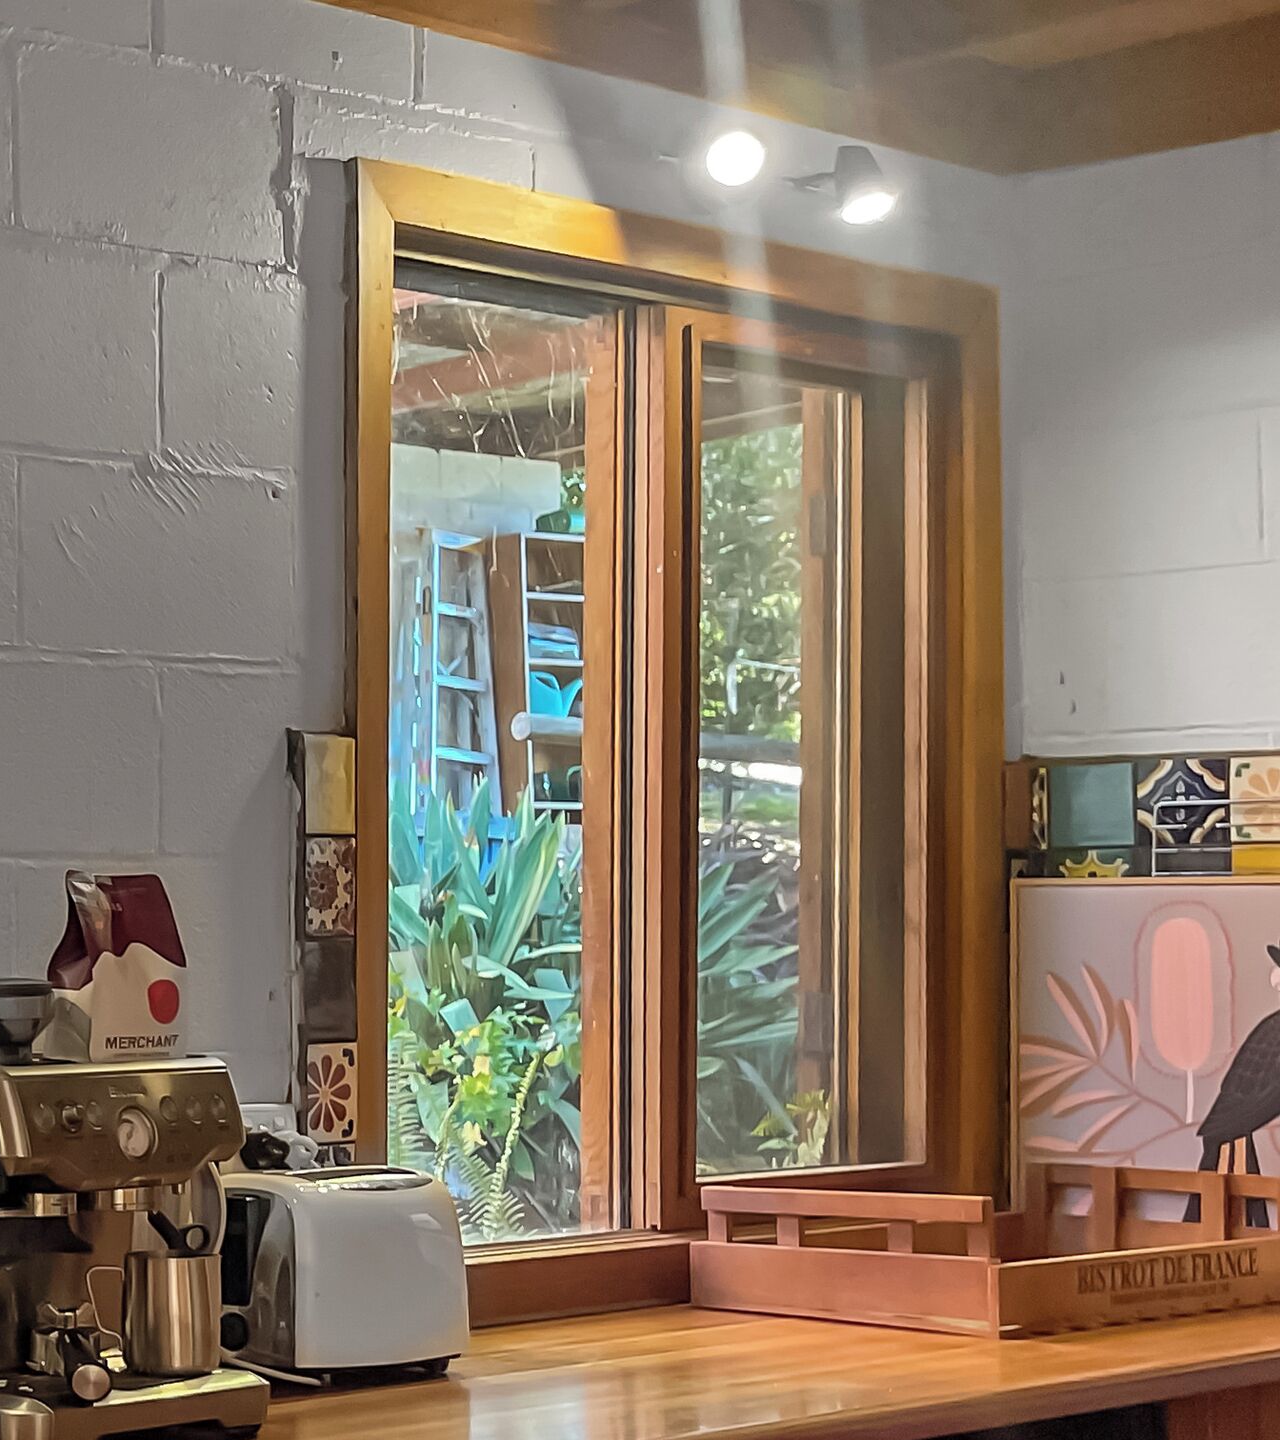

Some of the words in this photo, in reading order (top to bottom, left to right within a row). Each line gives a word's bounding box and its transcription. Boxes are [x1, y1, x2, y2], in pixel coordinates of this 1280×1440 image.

[105, 1034, 179, 1049] MERCHANT
[1077, 1257, 1160, 1294] BISTROT
[1162, 1255, 1188, 1285] DE
[1191, 1247, 1258, 1282] FRANCE
